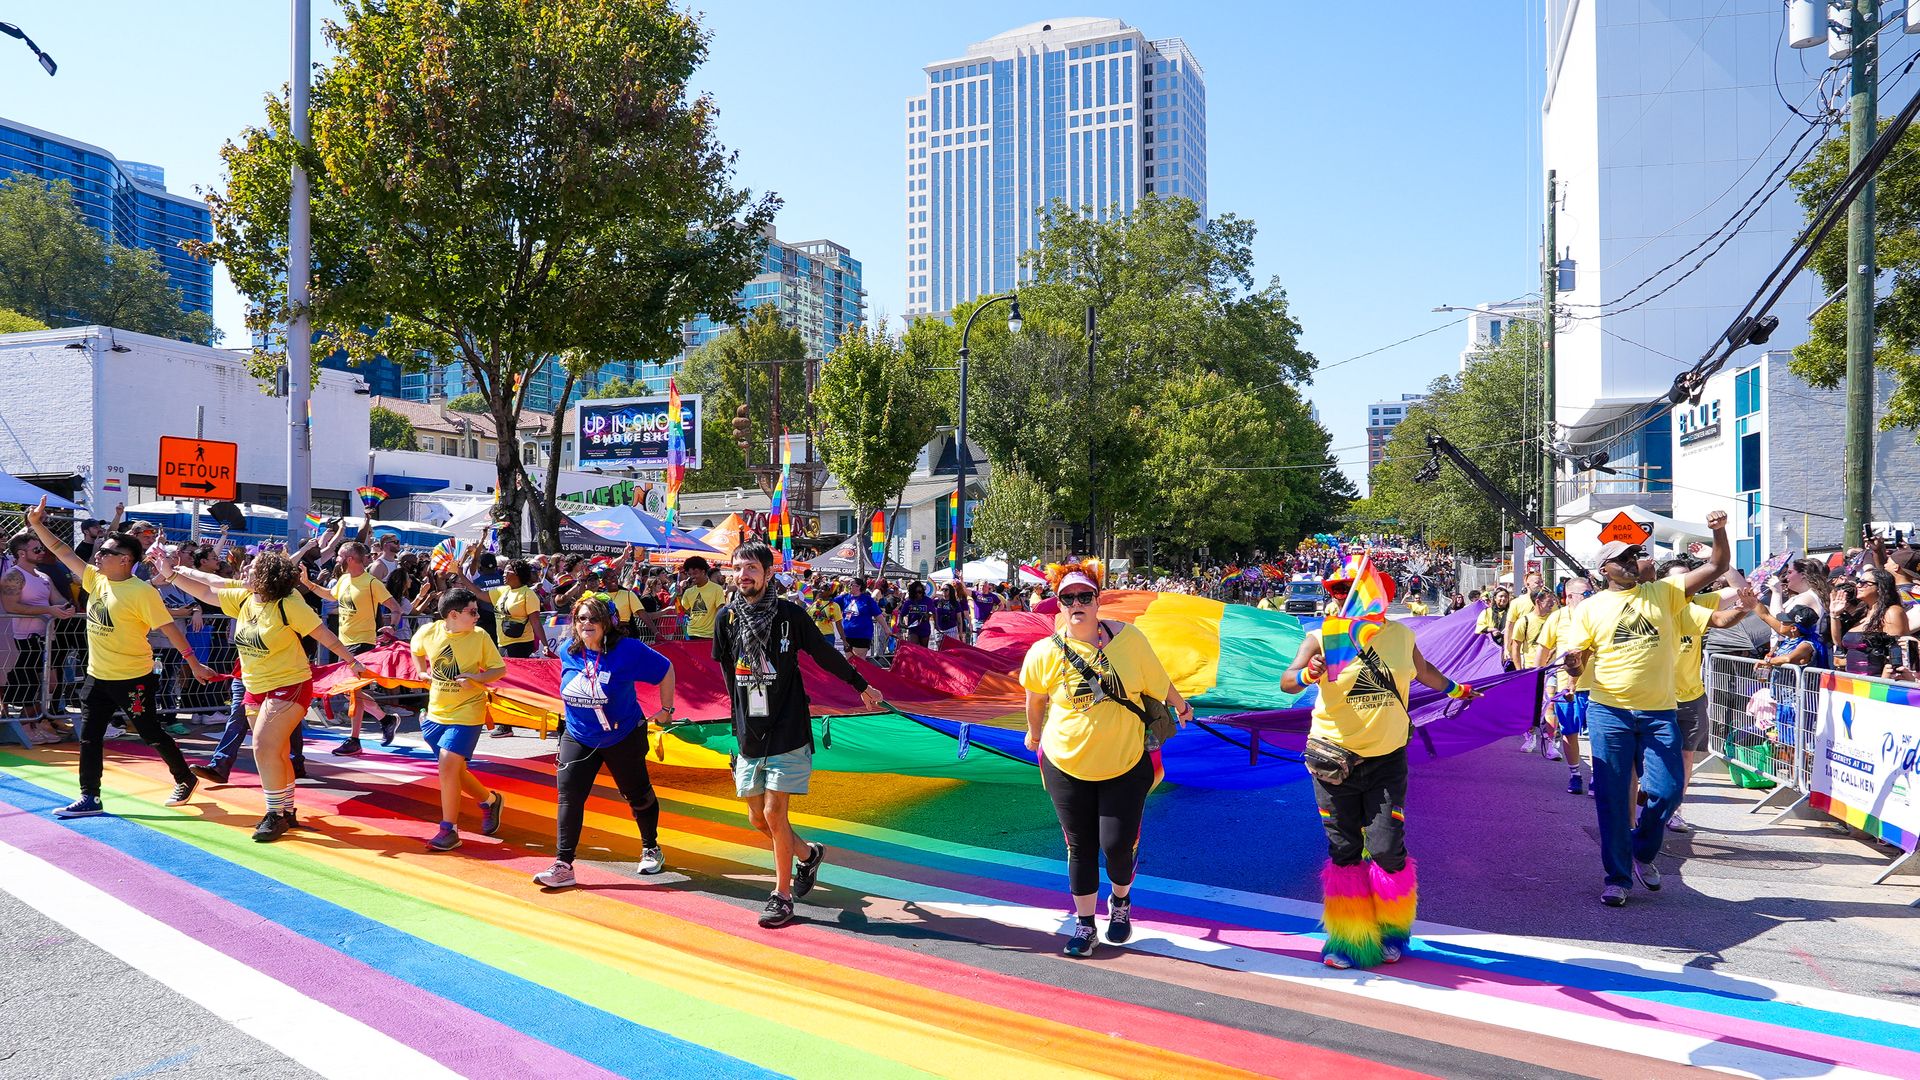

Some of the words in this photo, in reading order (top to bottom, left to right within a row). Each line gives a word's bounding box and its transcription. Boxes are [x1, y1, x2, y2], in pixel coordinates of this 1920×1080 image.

[1680, 399, 1721, 433] BLUE
[585, 416, 606, 433] UP
[612, 413, 626, 432] IN
[633, 411, 691, 432] SMOE
[592, 431, 670, 444] SMOKESHO
[107, 465, 124, 473] 990
[166, 462, 229, 479] DETOUR
[611, 546, 624, 554] VODK
[1073, 695, 1094, 704] UNITE
[1346, 696, 1370, 704] UNITED
[1861, 763, 1873, 772] LAW
